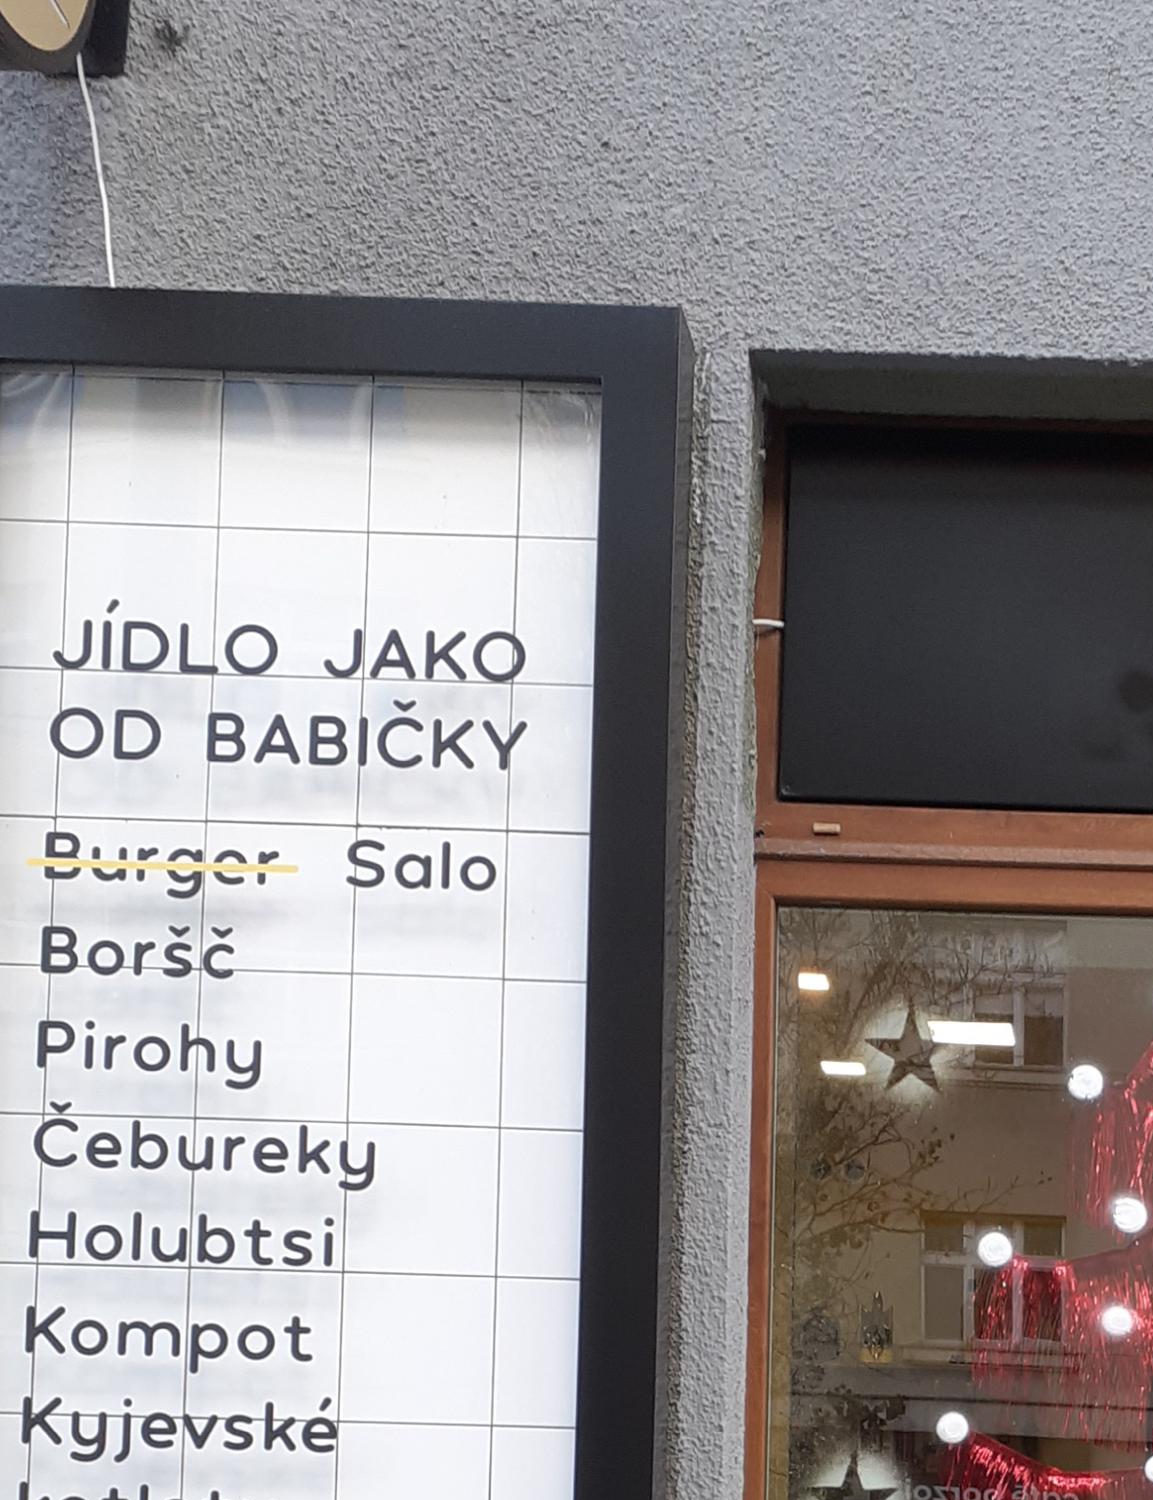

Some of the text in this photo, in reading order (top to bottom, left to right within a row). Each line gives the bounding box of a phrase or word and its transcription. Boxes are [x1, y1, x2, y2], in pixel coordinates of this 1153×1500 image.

[53, 600, 526, 682] JÍDLO JAKO
[49, 700, 527, 770] OD BABIČKY
[44, 831, 497, 898] Burger Salo
[40, 926, 235, 978] Boršč
[36, 1020, 262, 1089] Pirohy
[33, 1101, 376, 1190] Čebureky
[28, 1210, 334, 1266] Holubtsi
[24, 1305, 313, 1373] Kompot
[20, 1397, 338, 1462] Kyjevské
